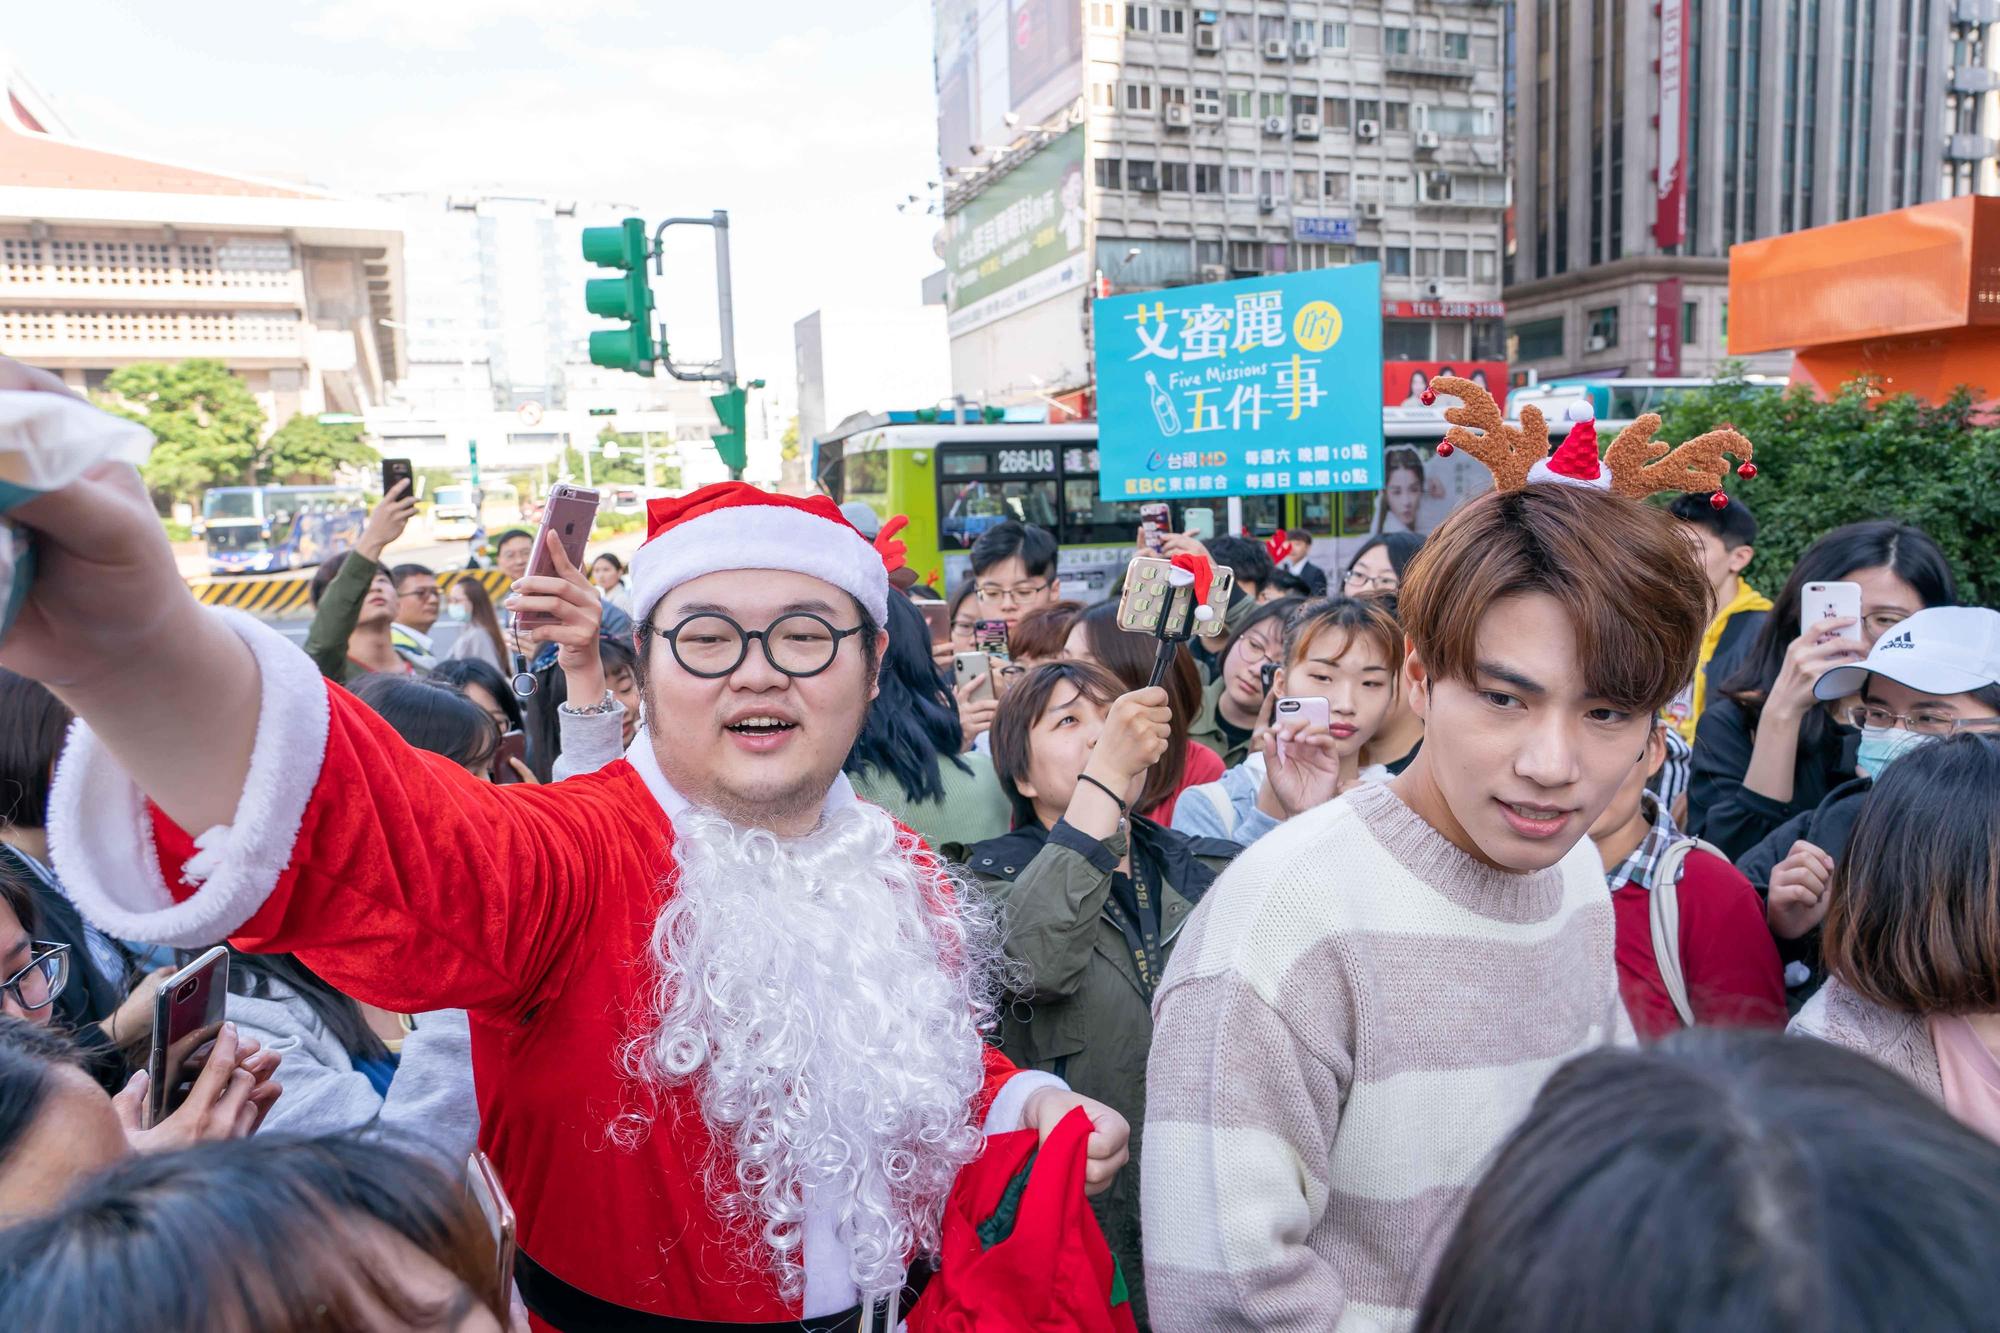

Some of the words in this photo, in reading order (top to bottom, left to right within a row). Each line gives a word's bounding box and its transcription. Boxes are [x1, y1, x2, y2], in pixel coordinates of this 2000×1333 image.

[1412, 302, 1434, 316] TEL
[1169, 371, 1201, 390] Five
[1206, 360, 1268, 383] Missions
[1184, 354, 1328, 433] 五件事
[998, 449, 1054, 473] 266-U3
[1245, 448, 1291, 466] 每週六
[1246, 472, 1290, 489] 每週日
[1880, 640, 1915, 650] adidas
